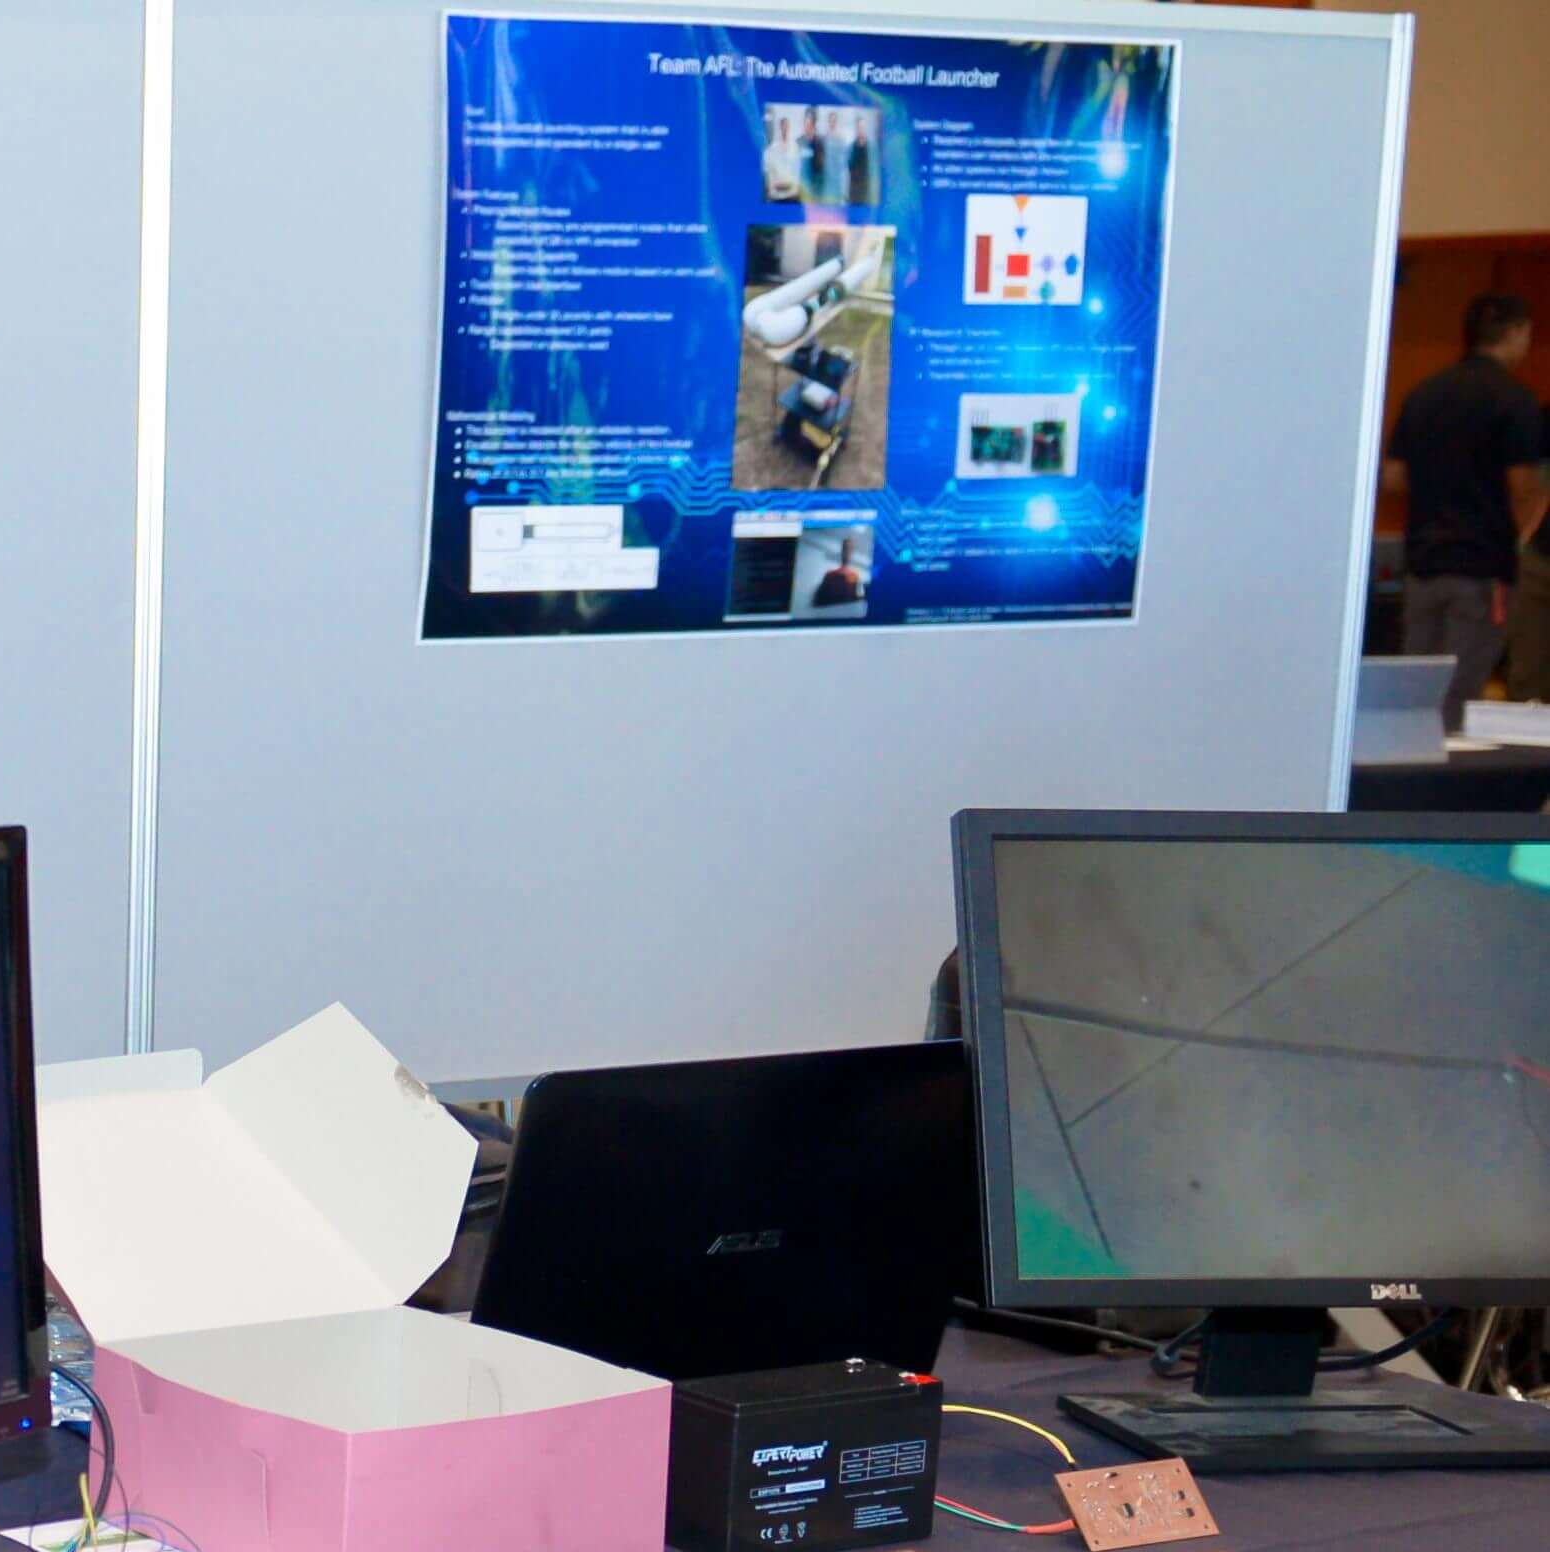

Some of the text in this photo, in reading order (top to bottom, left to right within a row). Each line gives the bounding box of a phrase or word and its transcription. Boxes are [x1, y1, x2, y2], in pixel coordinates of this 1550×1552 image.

[649, 52, 698, 75] Team
[745, 56, 775, 80] The
[776, 59, 860, 84] Automated
[859, 62, 924, 87] Football
[925, 67, 999, 87] Launcher
[1371, 1283, 1423, 1300] DELL
